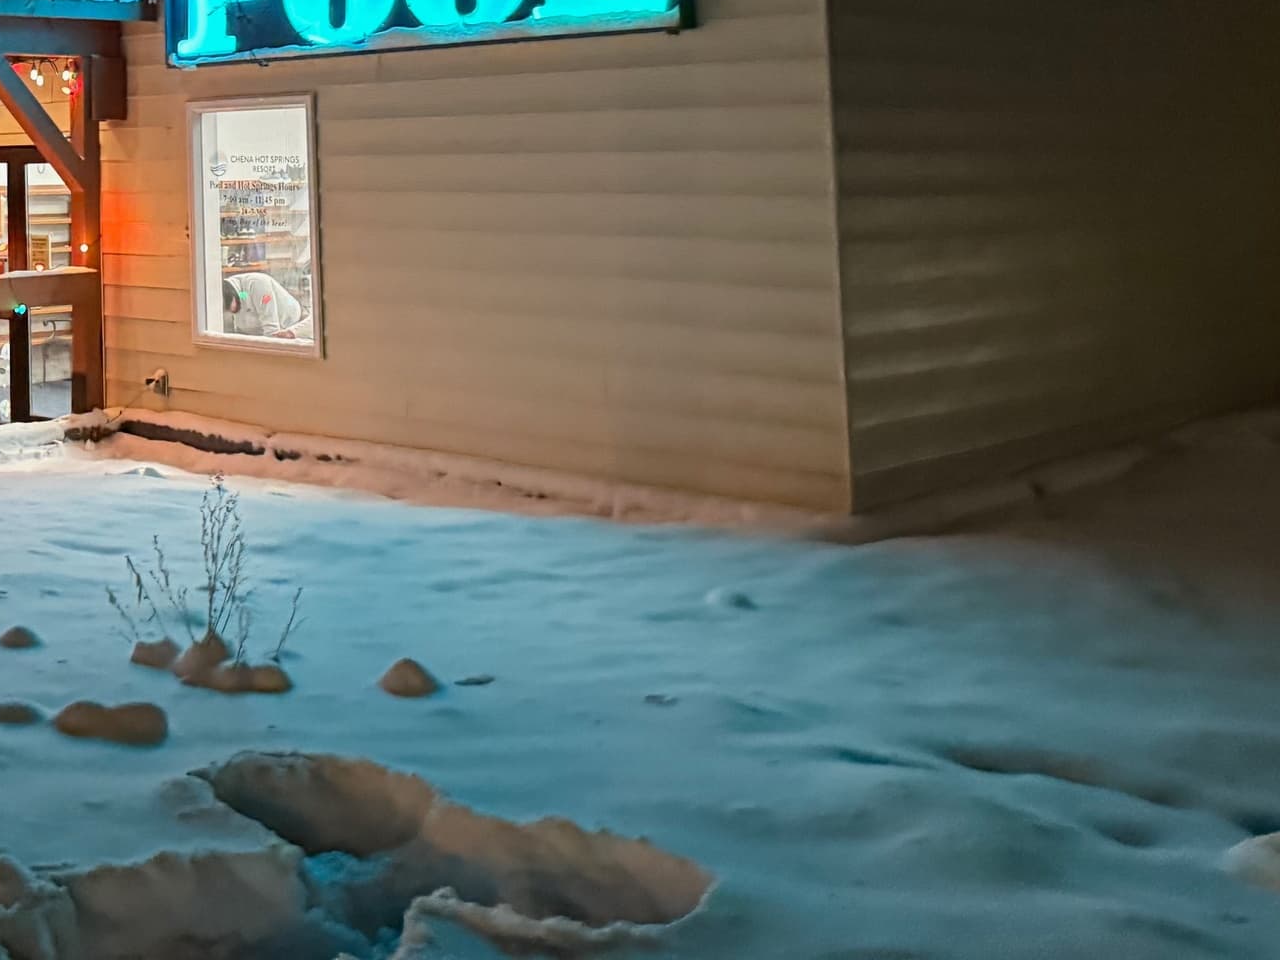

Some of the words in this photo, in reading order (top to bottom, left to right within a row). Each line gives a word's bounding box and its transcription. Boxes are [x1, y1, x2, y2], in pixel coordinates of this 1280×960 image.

[230, 155, 254, 163] CHENA
[255, 155, 269, 163] HOT
[270, 155, 300, 164] SPRINGS
[252, 165, 276, 173] RESORT
[278, 182, 300, 191] Hours
[273, 197, 286, 207] pm
